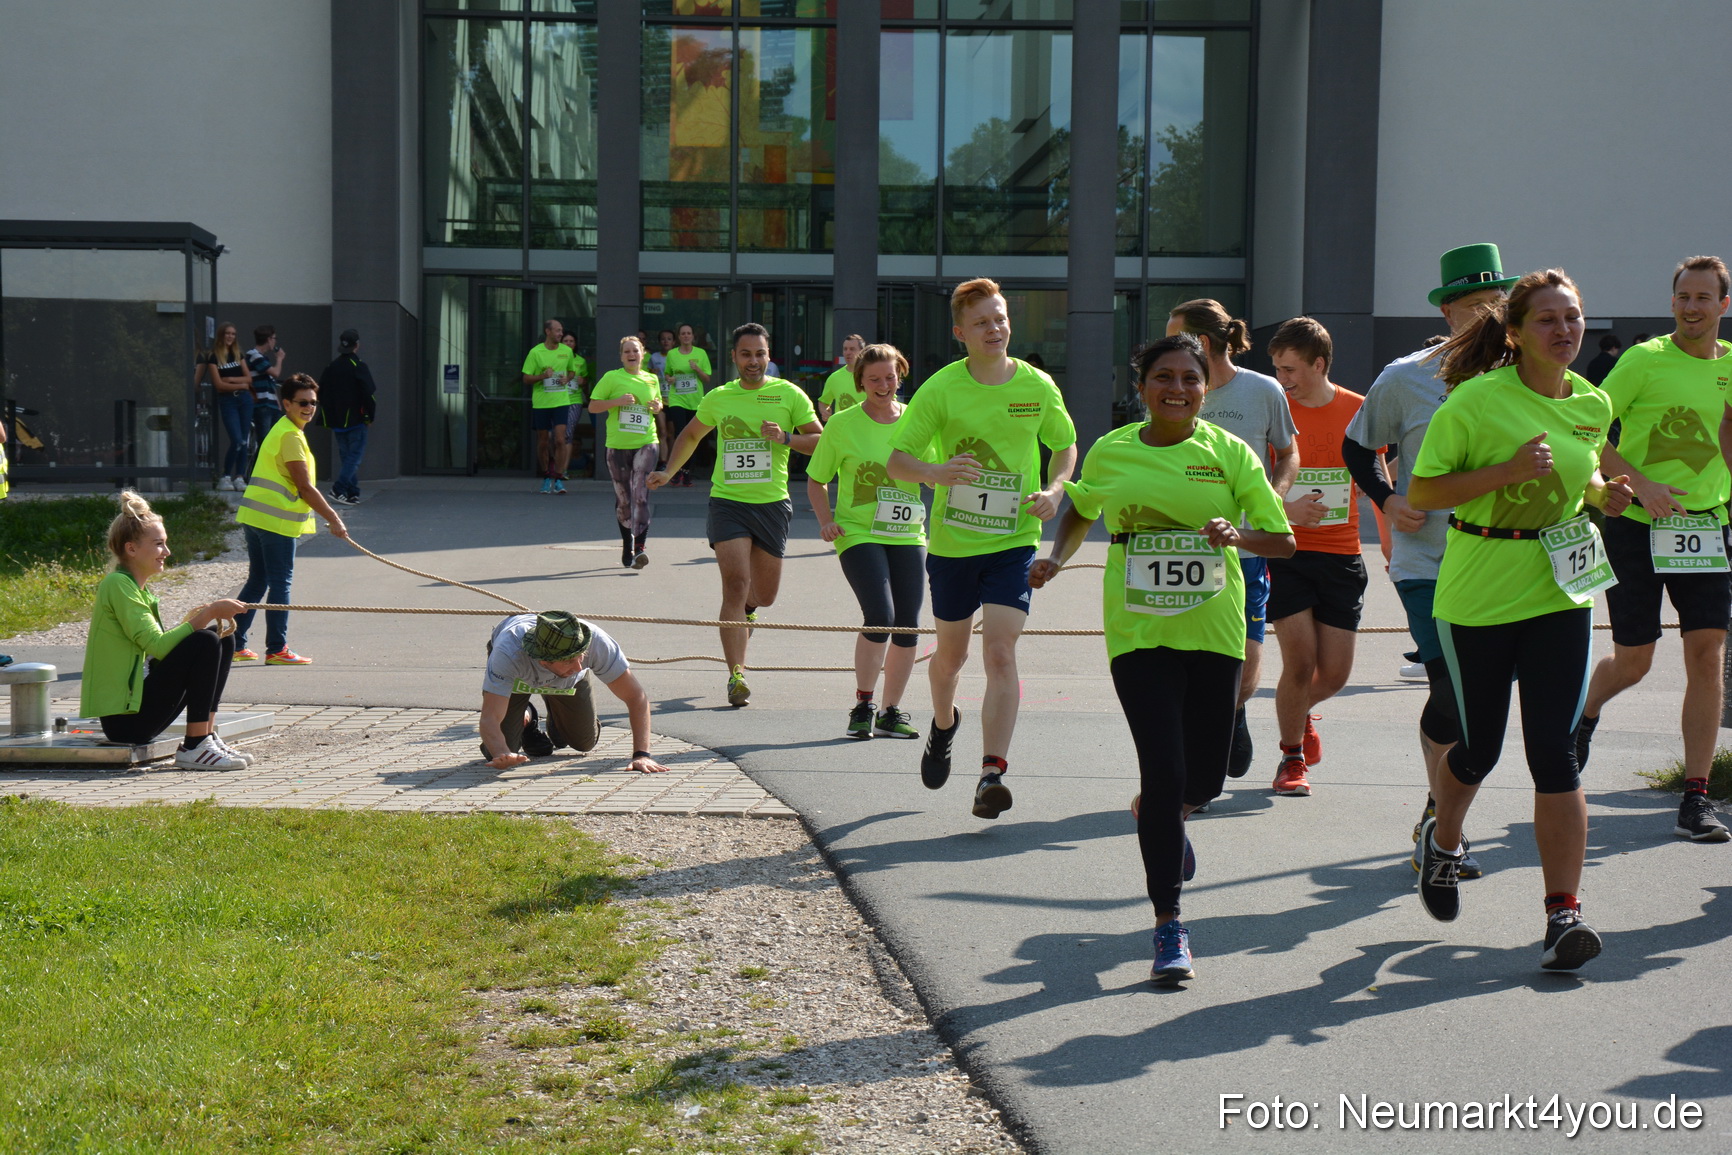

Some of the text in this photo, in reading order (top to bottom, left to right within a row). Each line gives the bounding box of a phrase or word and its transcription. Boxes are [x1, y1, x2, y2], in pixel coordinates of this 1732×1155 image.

[629, 414, 642, 423] 38
[726, 441, 767, 452] BOCK
[736, 454, 756, 468] 35
[729, 471, 764, 479] YOUSSEF
[971, 472, 1017, 490] OCK
[880, 489, 918, 503] BOCK
[978, 493, 988, 511] 1
[891, 505, 912, 521] 50
[951, 511, 1009, 528] JONATHAN
[886, 524, 910, 532] KATJA
[1656, 514, 1716, 530] BOCK
[1134, 534, 1215, 553] BOCK
[1674, 534, 1702, 553] 30
[1568, 541, 1596, 574] 151
[1668, 558, 1713, 567] STEFAN
[1147, 561, 1205, 586] 150
[1144, 594, 1204, 606] CECILIA
